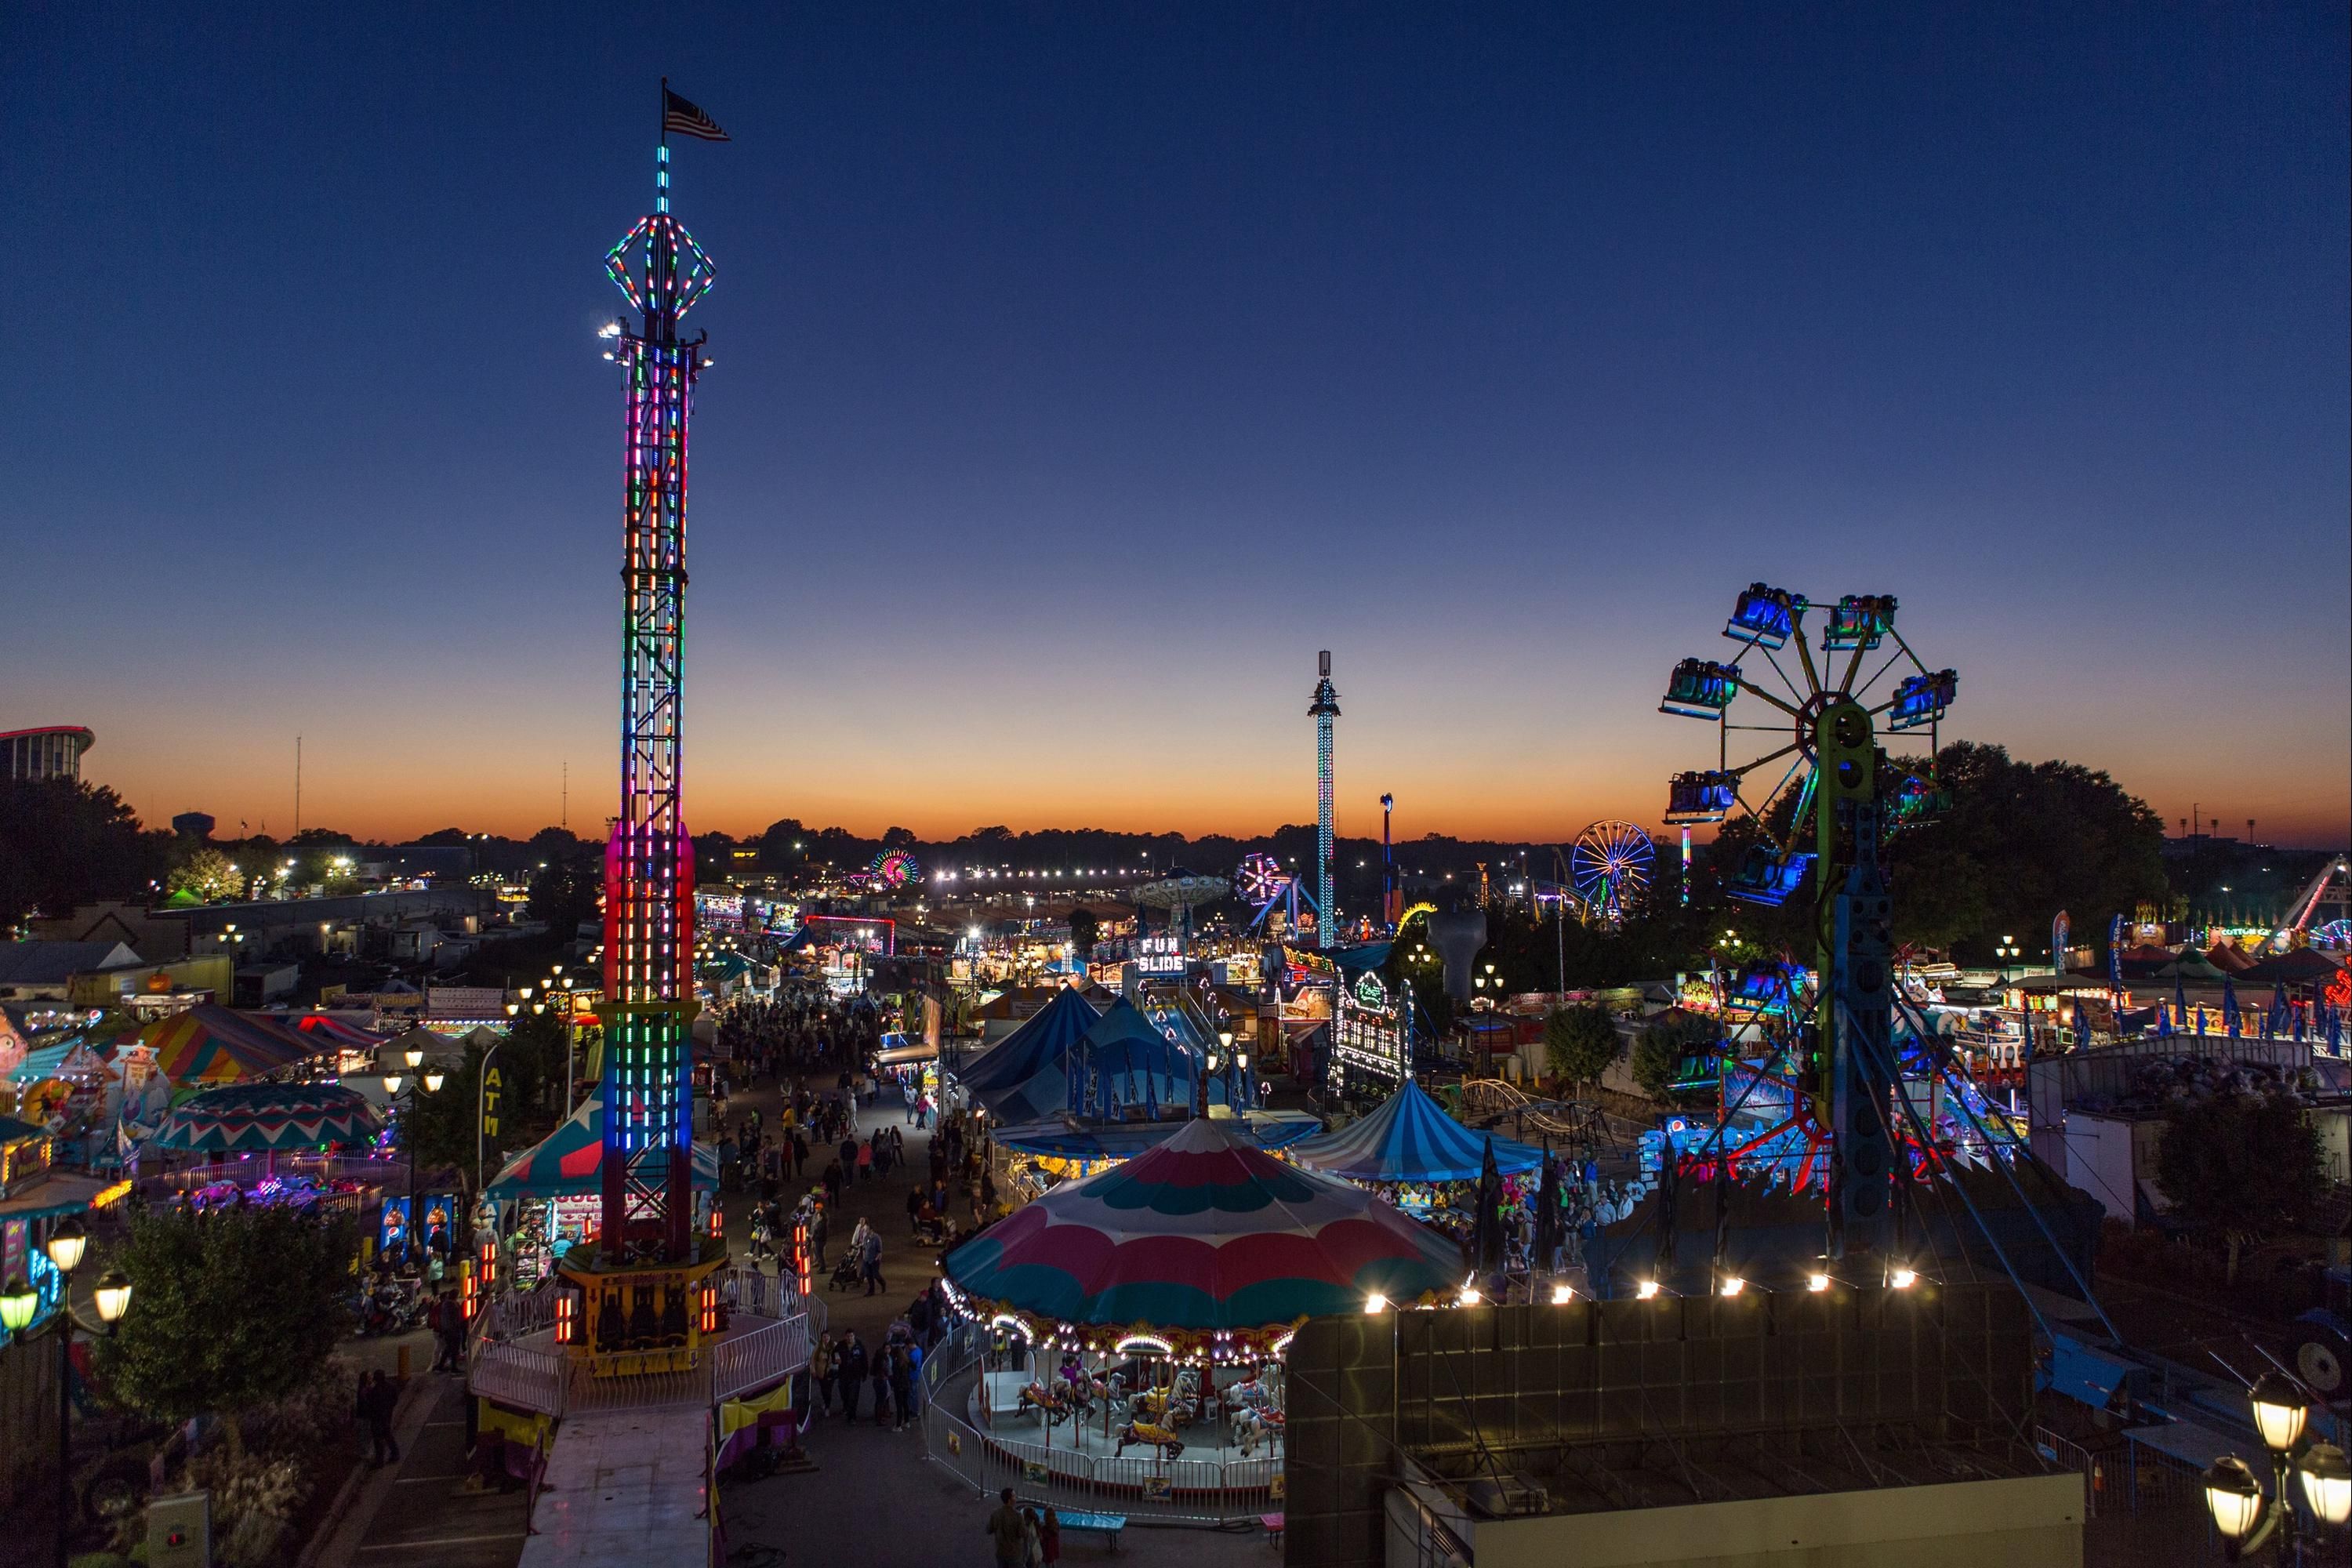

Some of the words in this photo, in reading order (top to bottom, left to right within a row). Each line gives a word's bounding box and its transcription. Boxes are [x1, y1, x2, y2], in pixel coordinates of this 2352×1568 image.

[2113, 913, 2124, 942] FISH
[1142, 938, 1178, 953] FUN
[1138, 956, 1183, 971] SLIDE
[2113, 948, 2122, 980] CHIPS
[1684, 980, 1710, 993] SAUSAGE
[1733, 1070, 1781, 1087] Airbush
[484, 1067, 503, 1138] ATM
